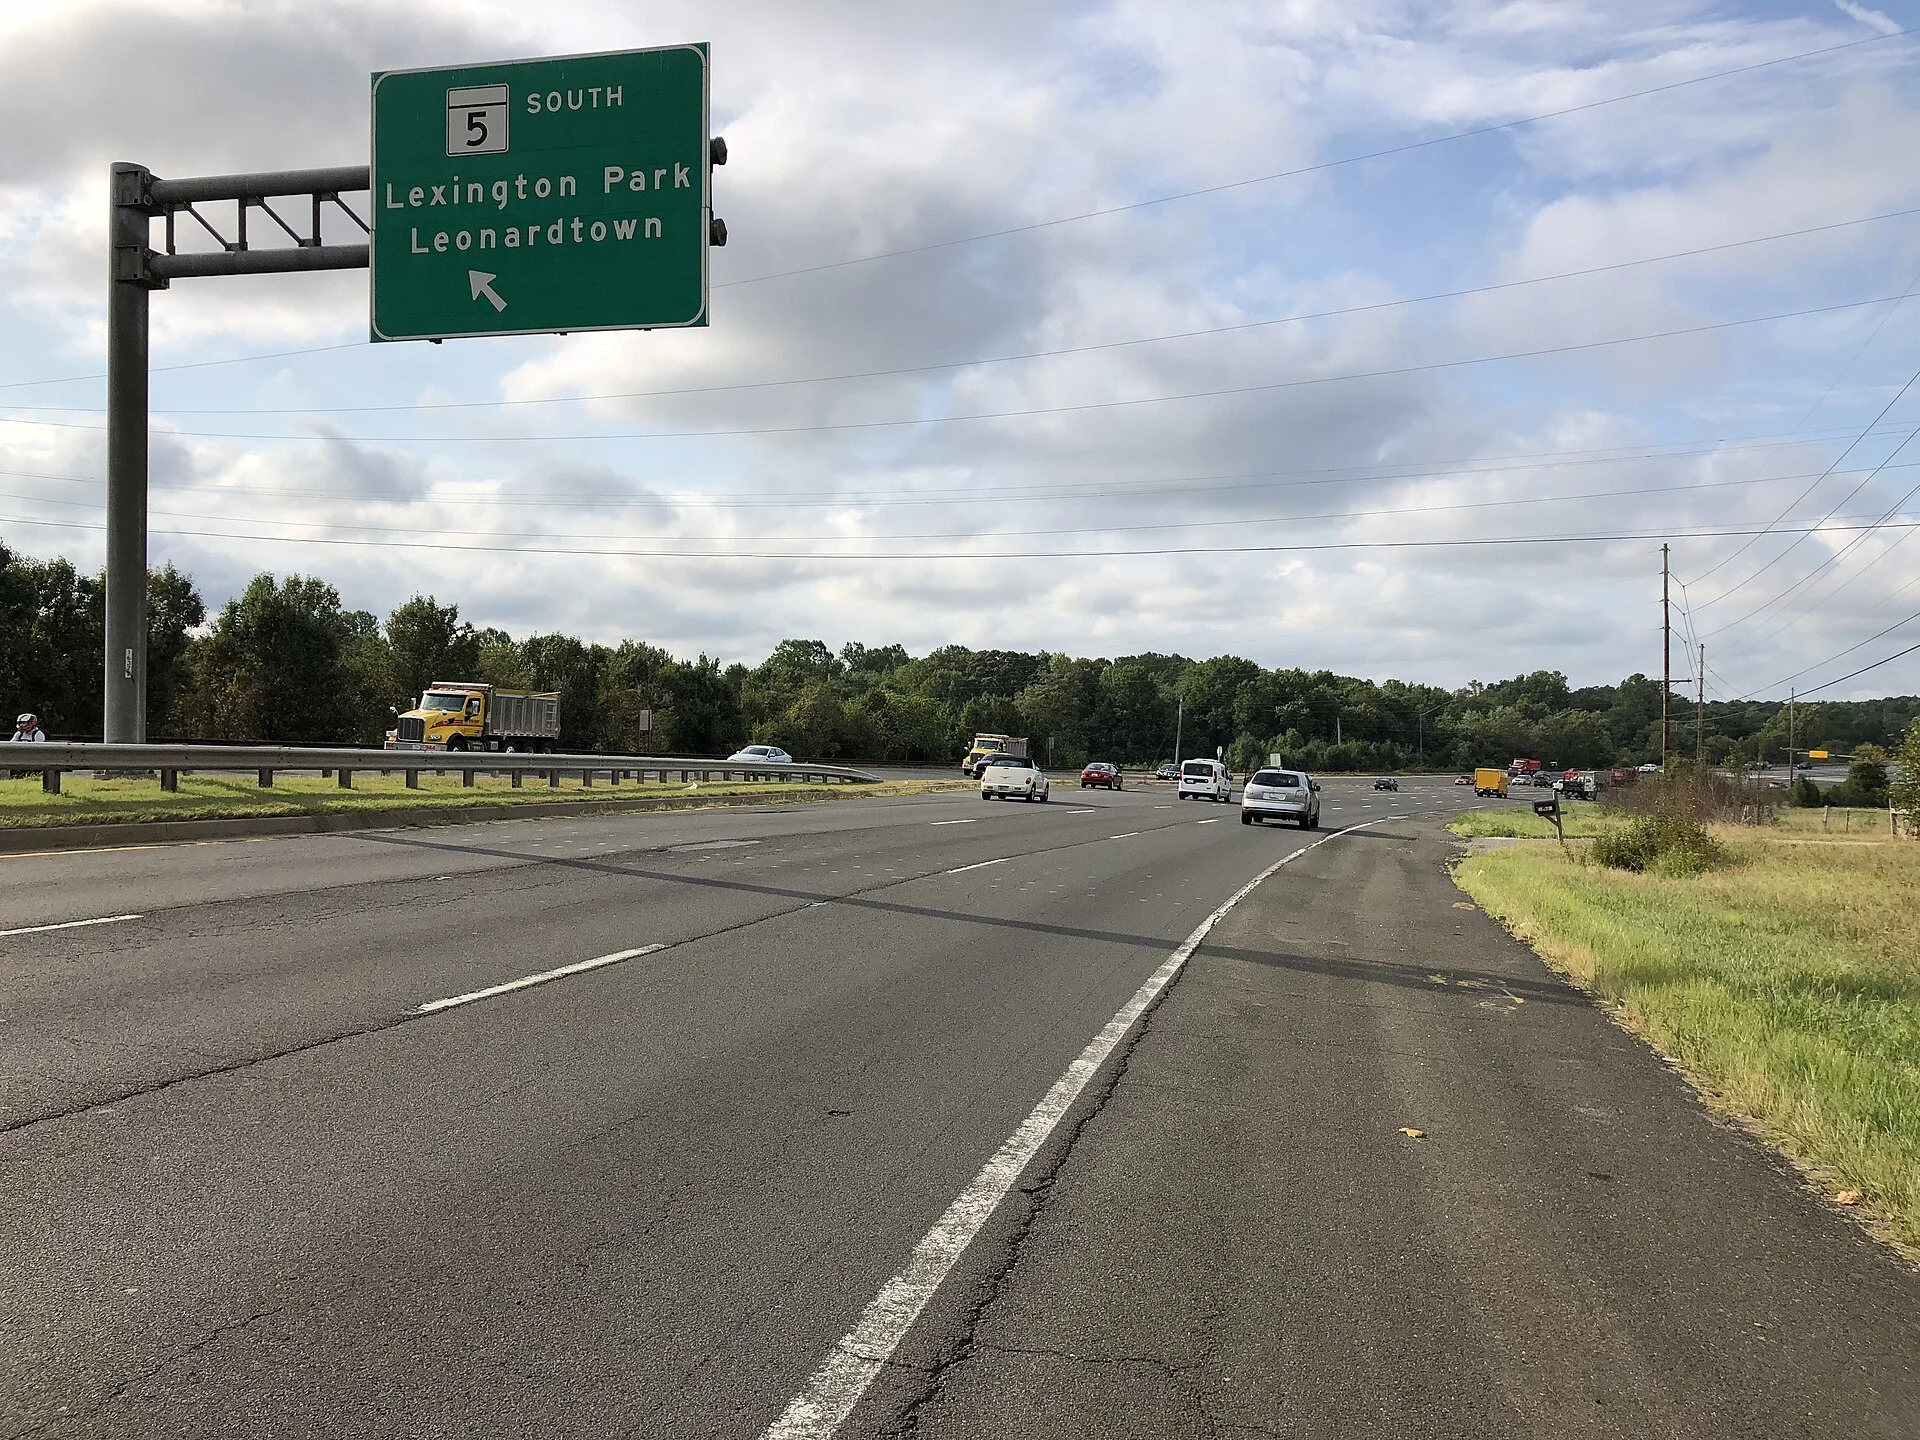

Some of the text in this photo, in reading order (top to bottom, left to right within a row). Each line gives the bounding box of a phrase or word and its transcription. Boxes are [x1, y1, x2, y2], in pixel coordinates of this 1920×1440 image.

[527, 86, 623, 114] SOUTH
[466, 111, 488, 147] 5
[386, 162, 690, 210] Lexington Park
[411, 216, 662, 254] Leonardtown
